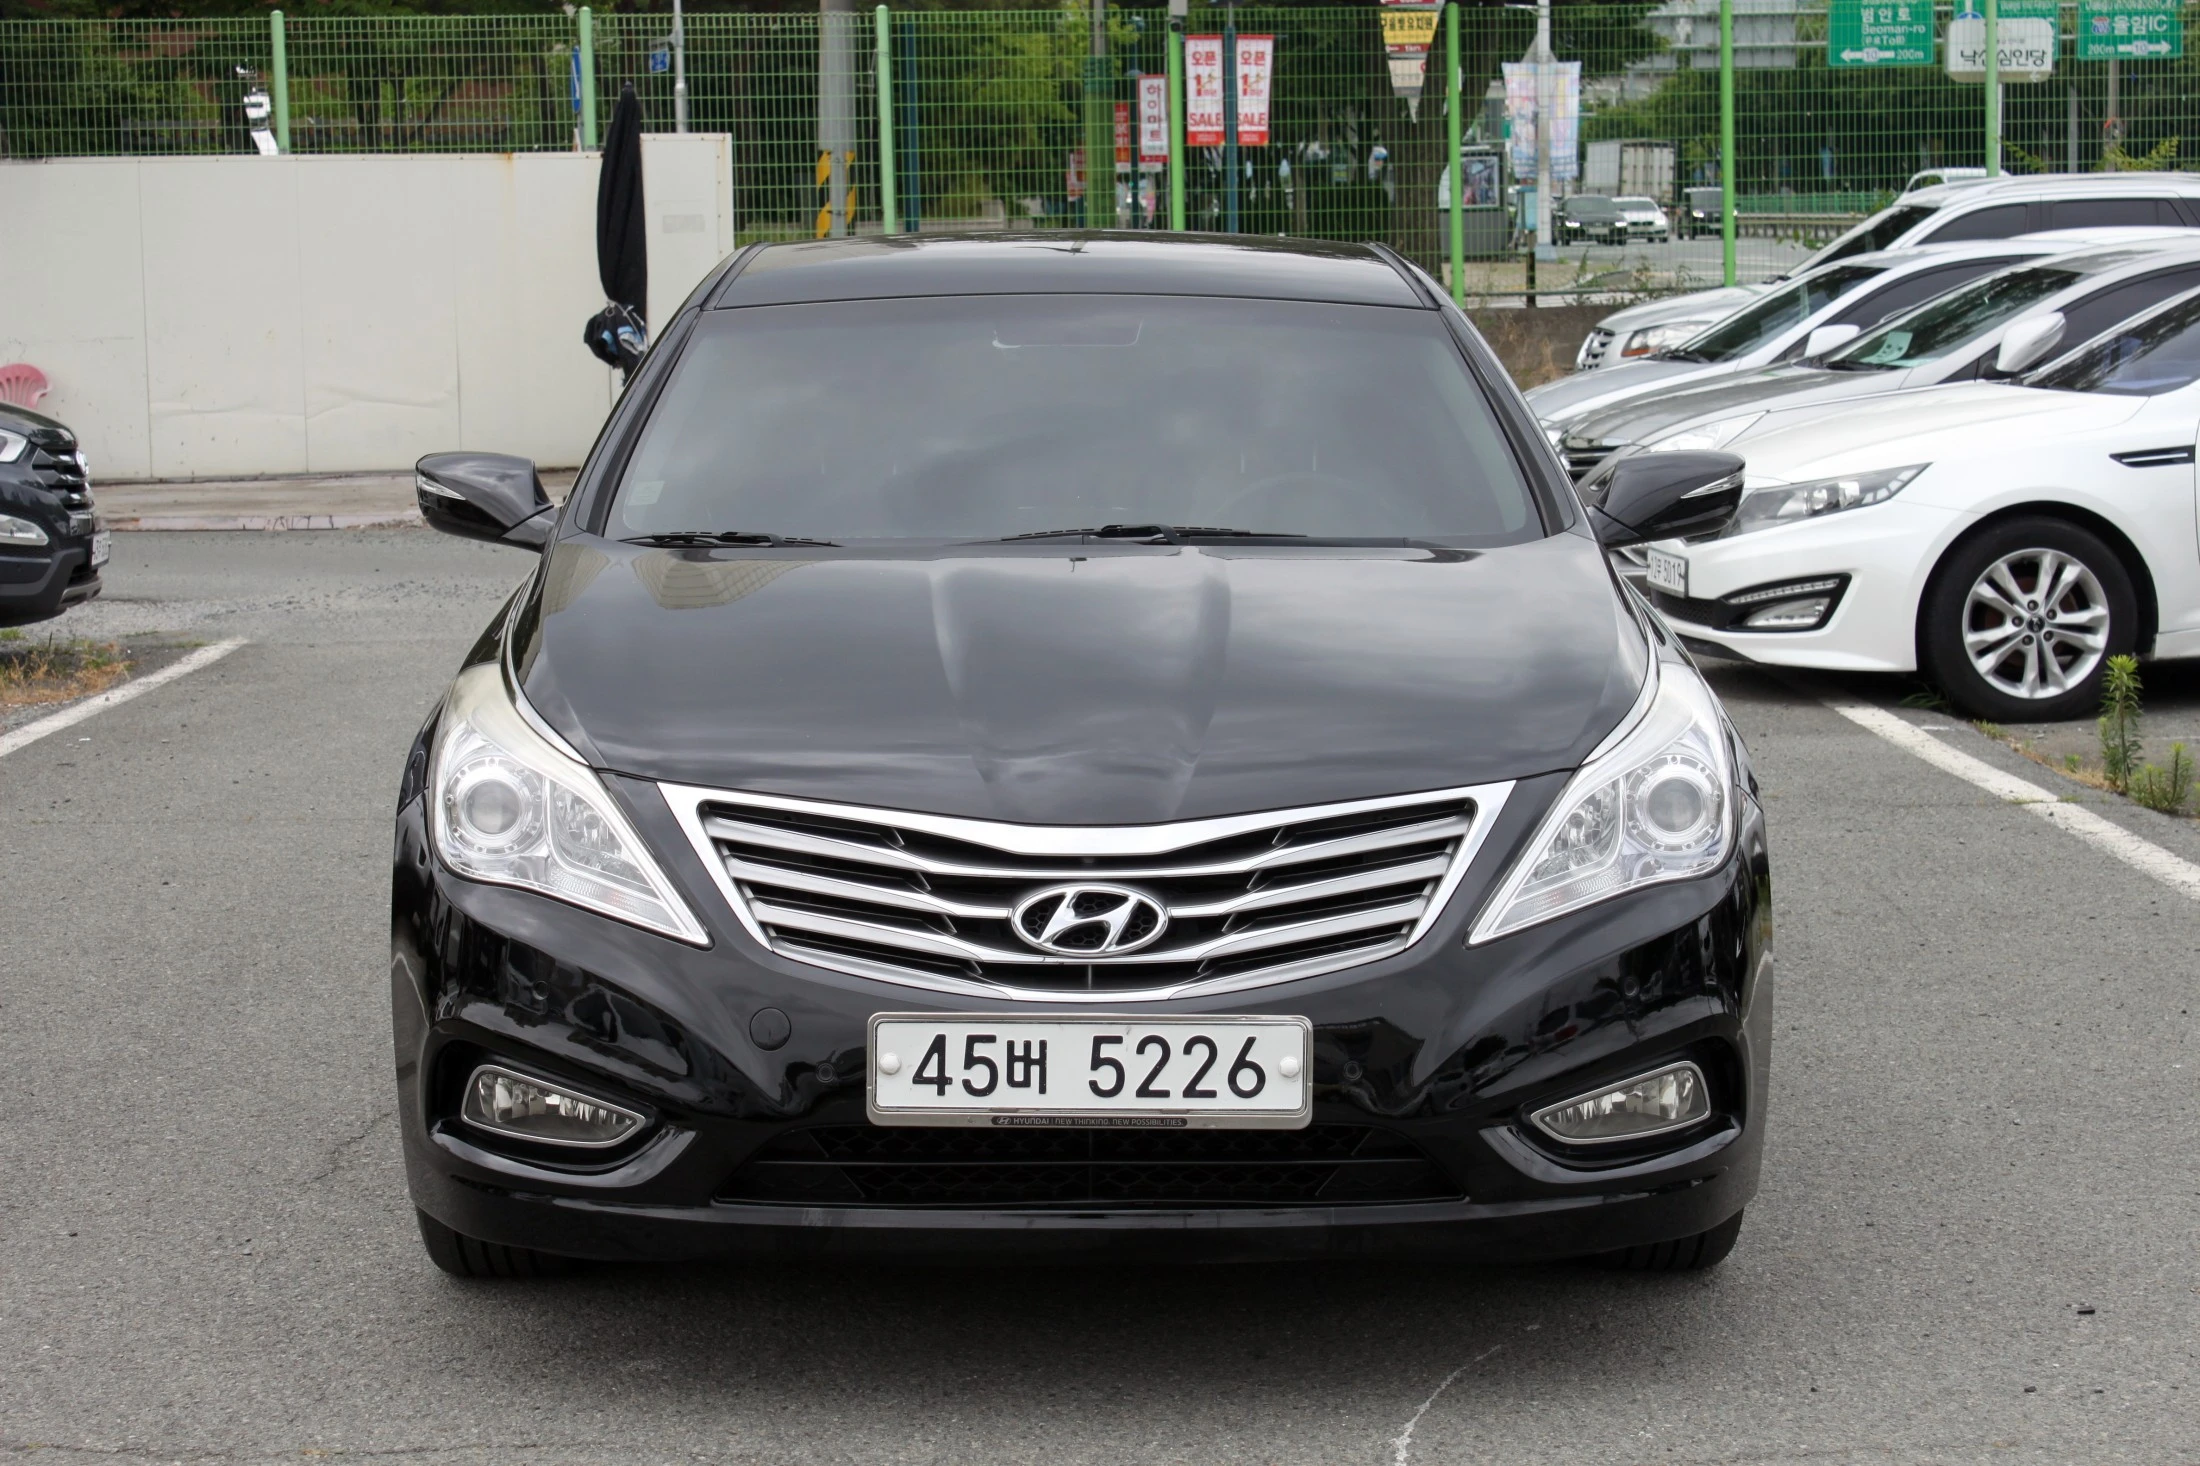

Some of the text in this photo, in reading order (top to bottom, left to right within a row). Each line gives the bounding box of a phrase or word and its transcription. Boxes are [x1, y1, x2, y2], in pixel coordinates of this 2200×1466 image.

[1862, 24, 1926, 34] Beoman-ro
[1192, 51, 1217, 66] 오픈
[1240, 51, 1265, 66] 오픈
[1146, 84, 1163, 141] 하이마트
[1189, 112, 1222, 127] SALE
[1664, 559, 1682, 587] 5019
[912, 1033, 1266, 1099] 45버 5226
